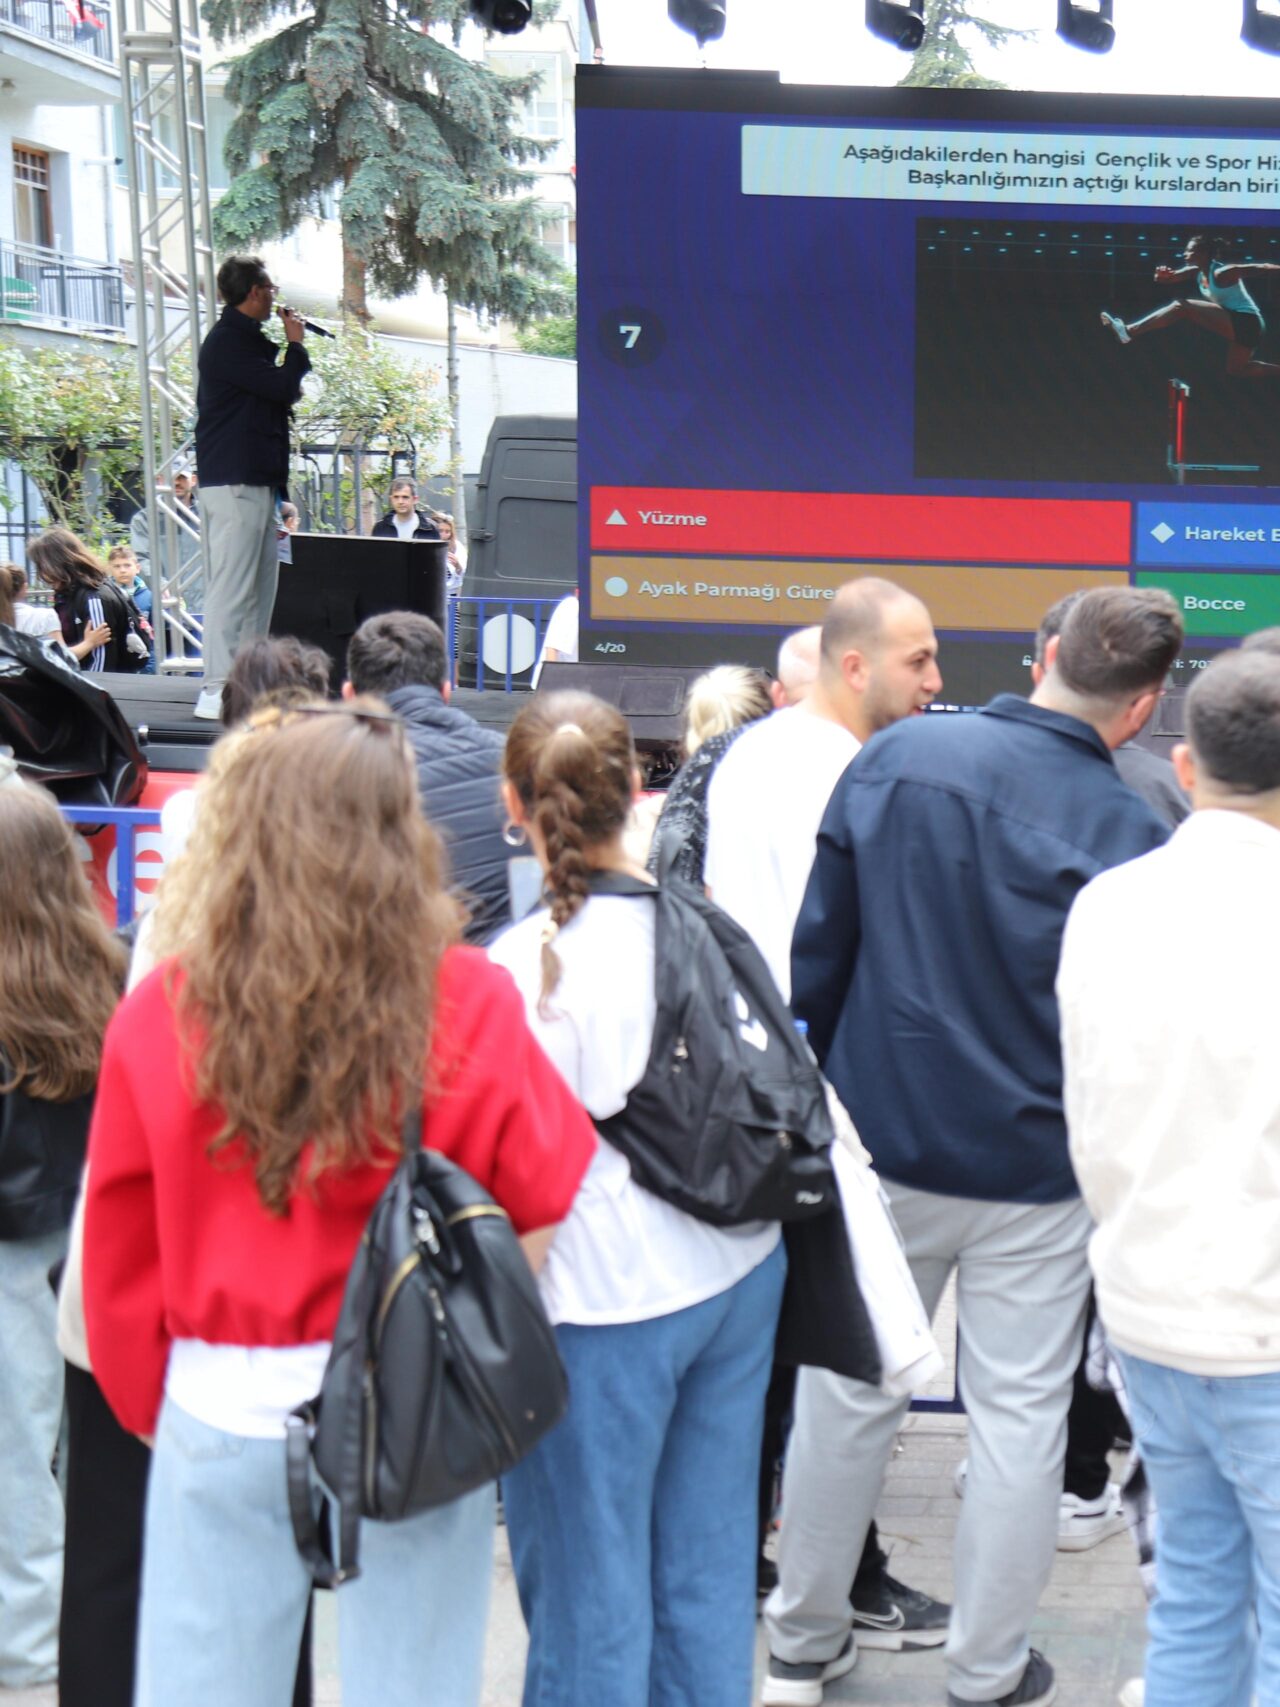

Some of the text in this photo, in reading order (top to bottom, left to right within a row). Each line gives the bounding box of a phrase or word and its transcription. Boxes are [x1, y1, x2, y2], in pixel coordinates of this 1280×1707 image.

[843, 144, 1008, 165] Aşağıdakilerden
[1014, 148, 1085, 168] hangisi
[1096, 151, 1172, 172] Gençlik
[1177, 156, 1200, 168] ve
[1205, 154, 1251, 174] Spor
[908, 169, 1068, 190] Başkanlığımızın
[1073, 173, 1128, 193] açtığı
[1134, 175, 1242, 193] kurslardan
[1247, 177, 1278, 193] biri
[619, 325, 642, 349] 7
[638, 510, 708, 527] Yüzme
[1184, 526, 1266, 542] Hareket
[638, 580, 838, 601] Ayak Parmağı Güre
[1183, 595, 1246, 611] Bocce
[594, 642, 627, 654] 4/20
